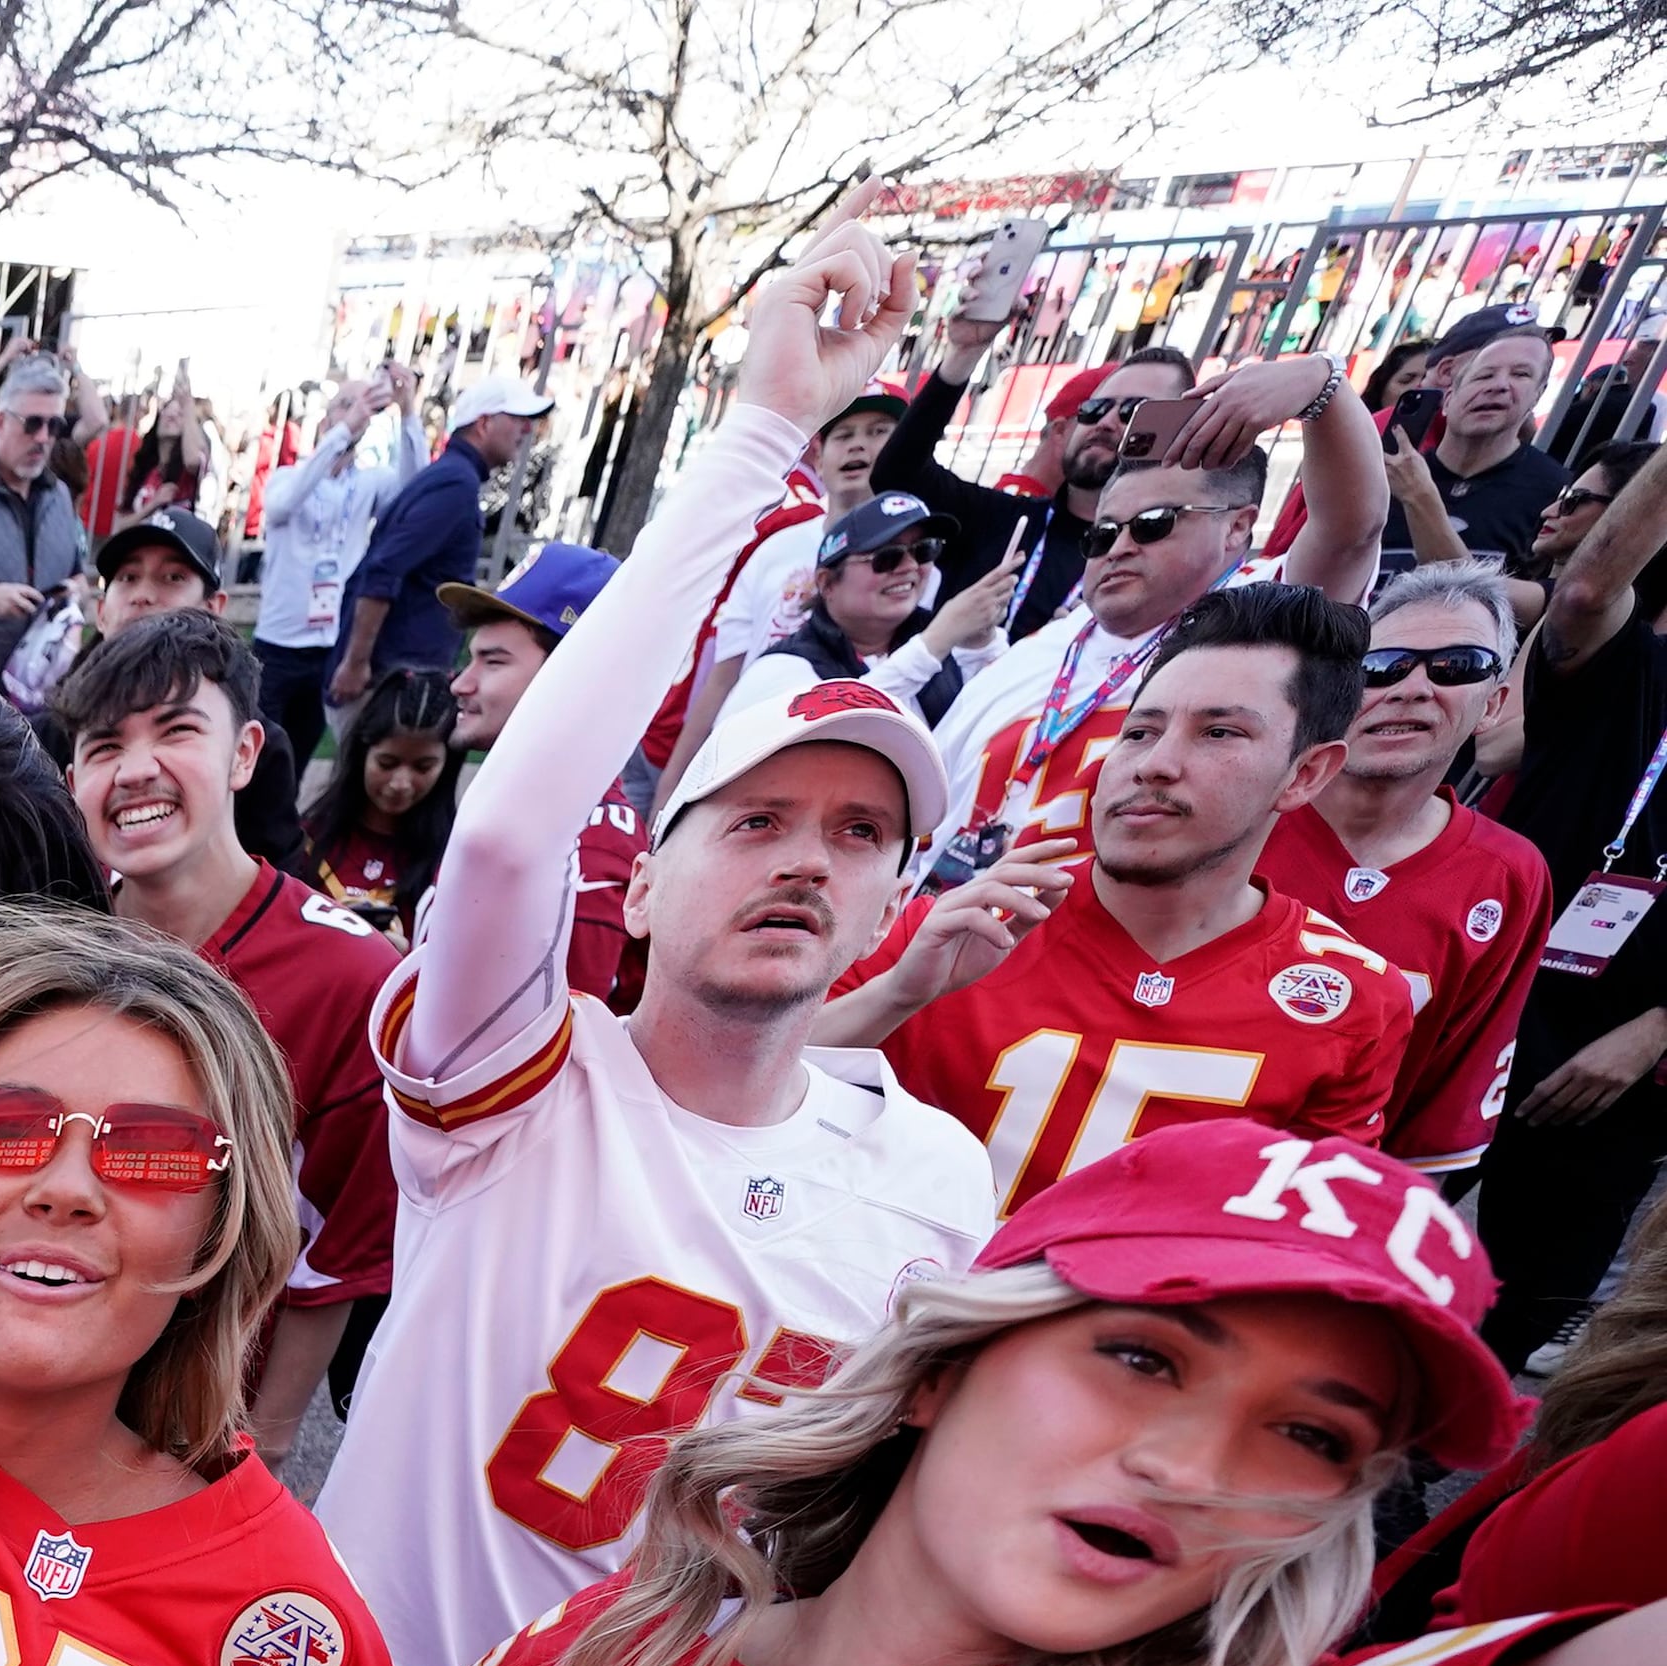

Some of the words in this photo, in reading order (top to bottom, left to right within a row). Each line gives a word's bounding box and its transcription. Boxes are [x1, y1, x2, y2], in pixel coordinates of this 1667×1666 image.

[299, 892, 373, 939] 6
[745, 1191, 780, 1219] NFL
[1222, 1138, 1473, 1308] KC
[31, 1552, 88, 1593] NFL
